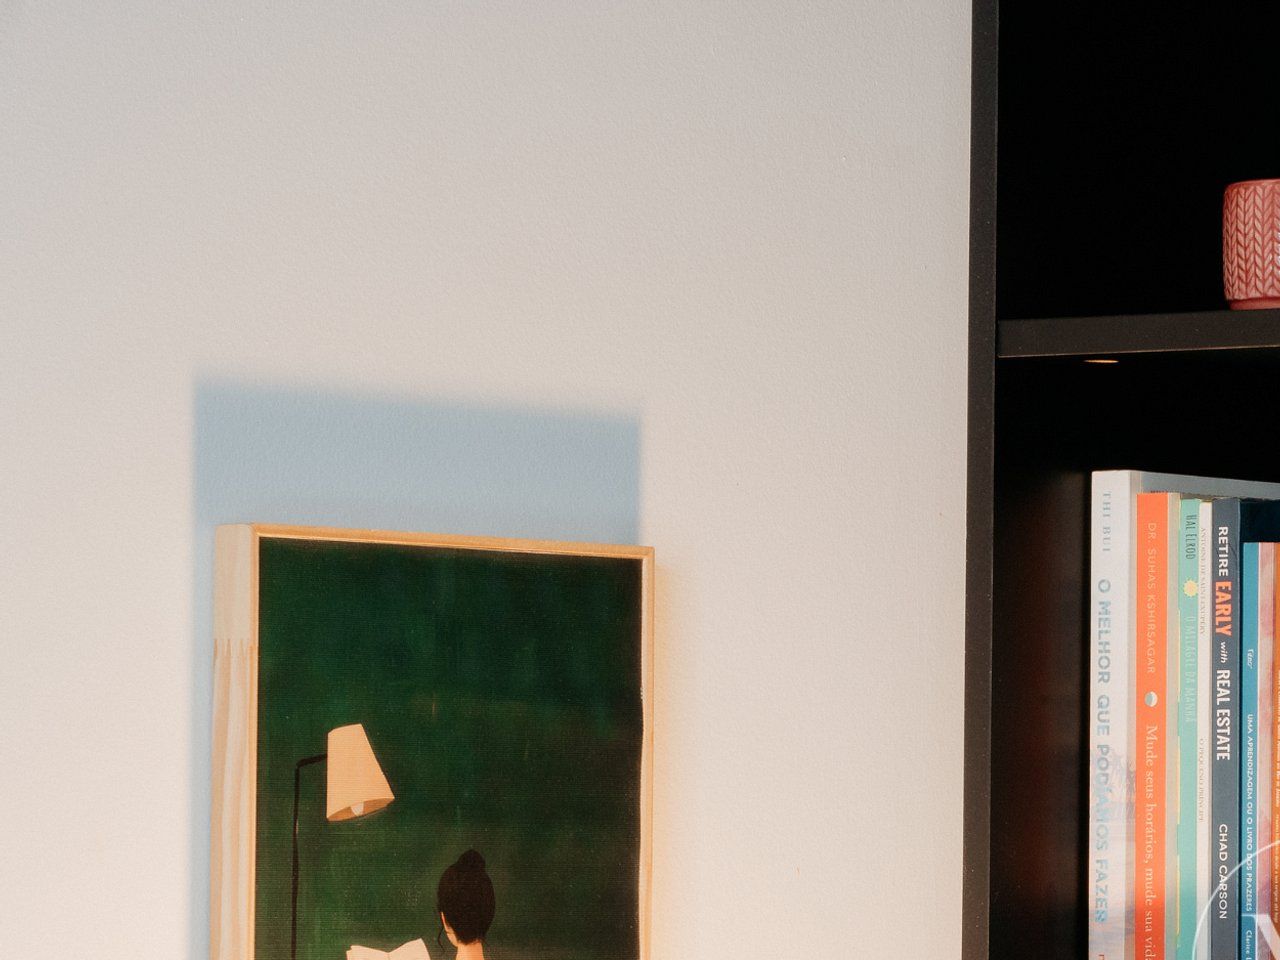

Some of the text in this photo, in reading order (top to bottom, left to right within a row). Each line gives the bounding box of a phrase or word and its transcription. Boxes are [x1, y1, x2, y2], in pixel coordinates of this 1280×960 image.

[1098, 579, 1111, 594] O
[1146, 522, 1157, 674] DR. SUHAS KSHIRSAGAR
[1097, 601, 1112, 684] MELHOR
[1215, 526, 1233, 761] RETIRE EARLY with REAL ESTATE
[1095, 694, 1110, 737] QUE
[1145, 725, 1159, 768] Mude
[1145, 770, 1155, 800] seus
[1143, 802, 1158, 865] horários,
[1245, 713, 1255, 912] UMA APRENDIZAGEM OU O LIVRO DOS PRAZERES
[1095, 858, 1109, 924] FAZER
[1144, 868, 1156, 907] mude
[1217, 823, 1229, 920] CHAD CARSON
[1143, 910, 1153, 933] sua
[1245, 929, 1253, 955] Clarice
